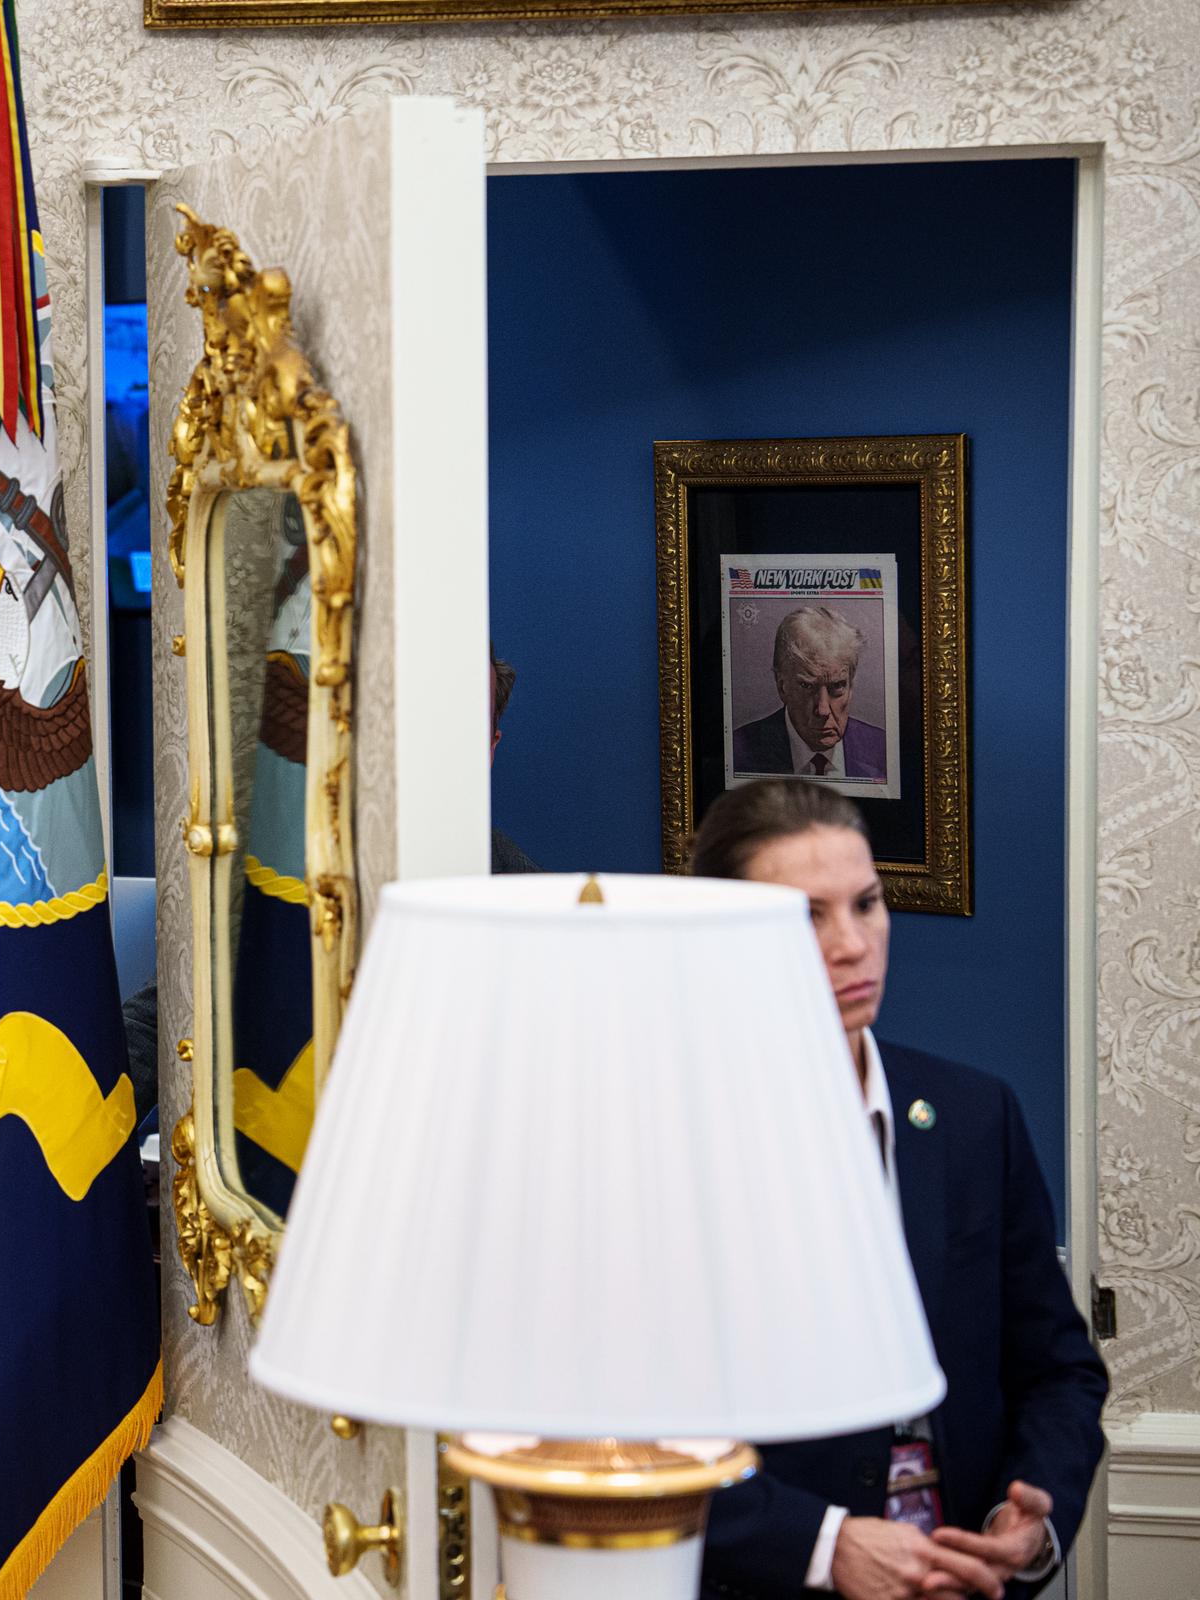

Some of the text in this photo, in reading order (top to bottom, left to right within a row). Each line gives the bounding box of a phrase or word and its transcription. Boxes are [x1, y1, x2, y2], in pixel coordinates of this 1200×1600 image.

[754, 569, 858, 589] NEW YORK POST
